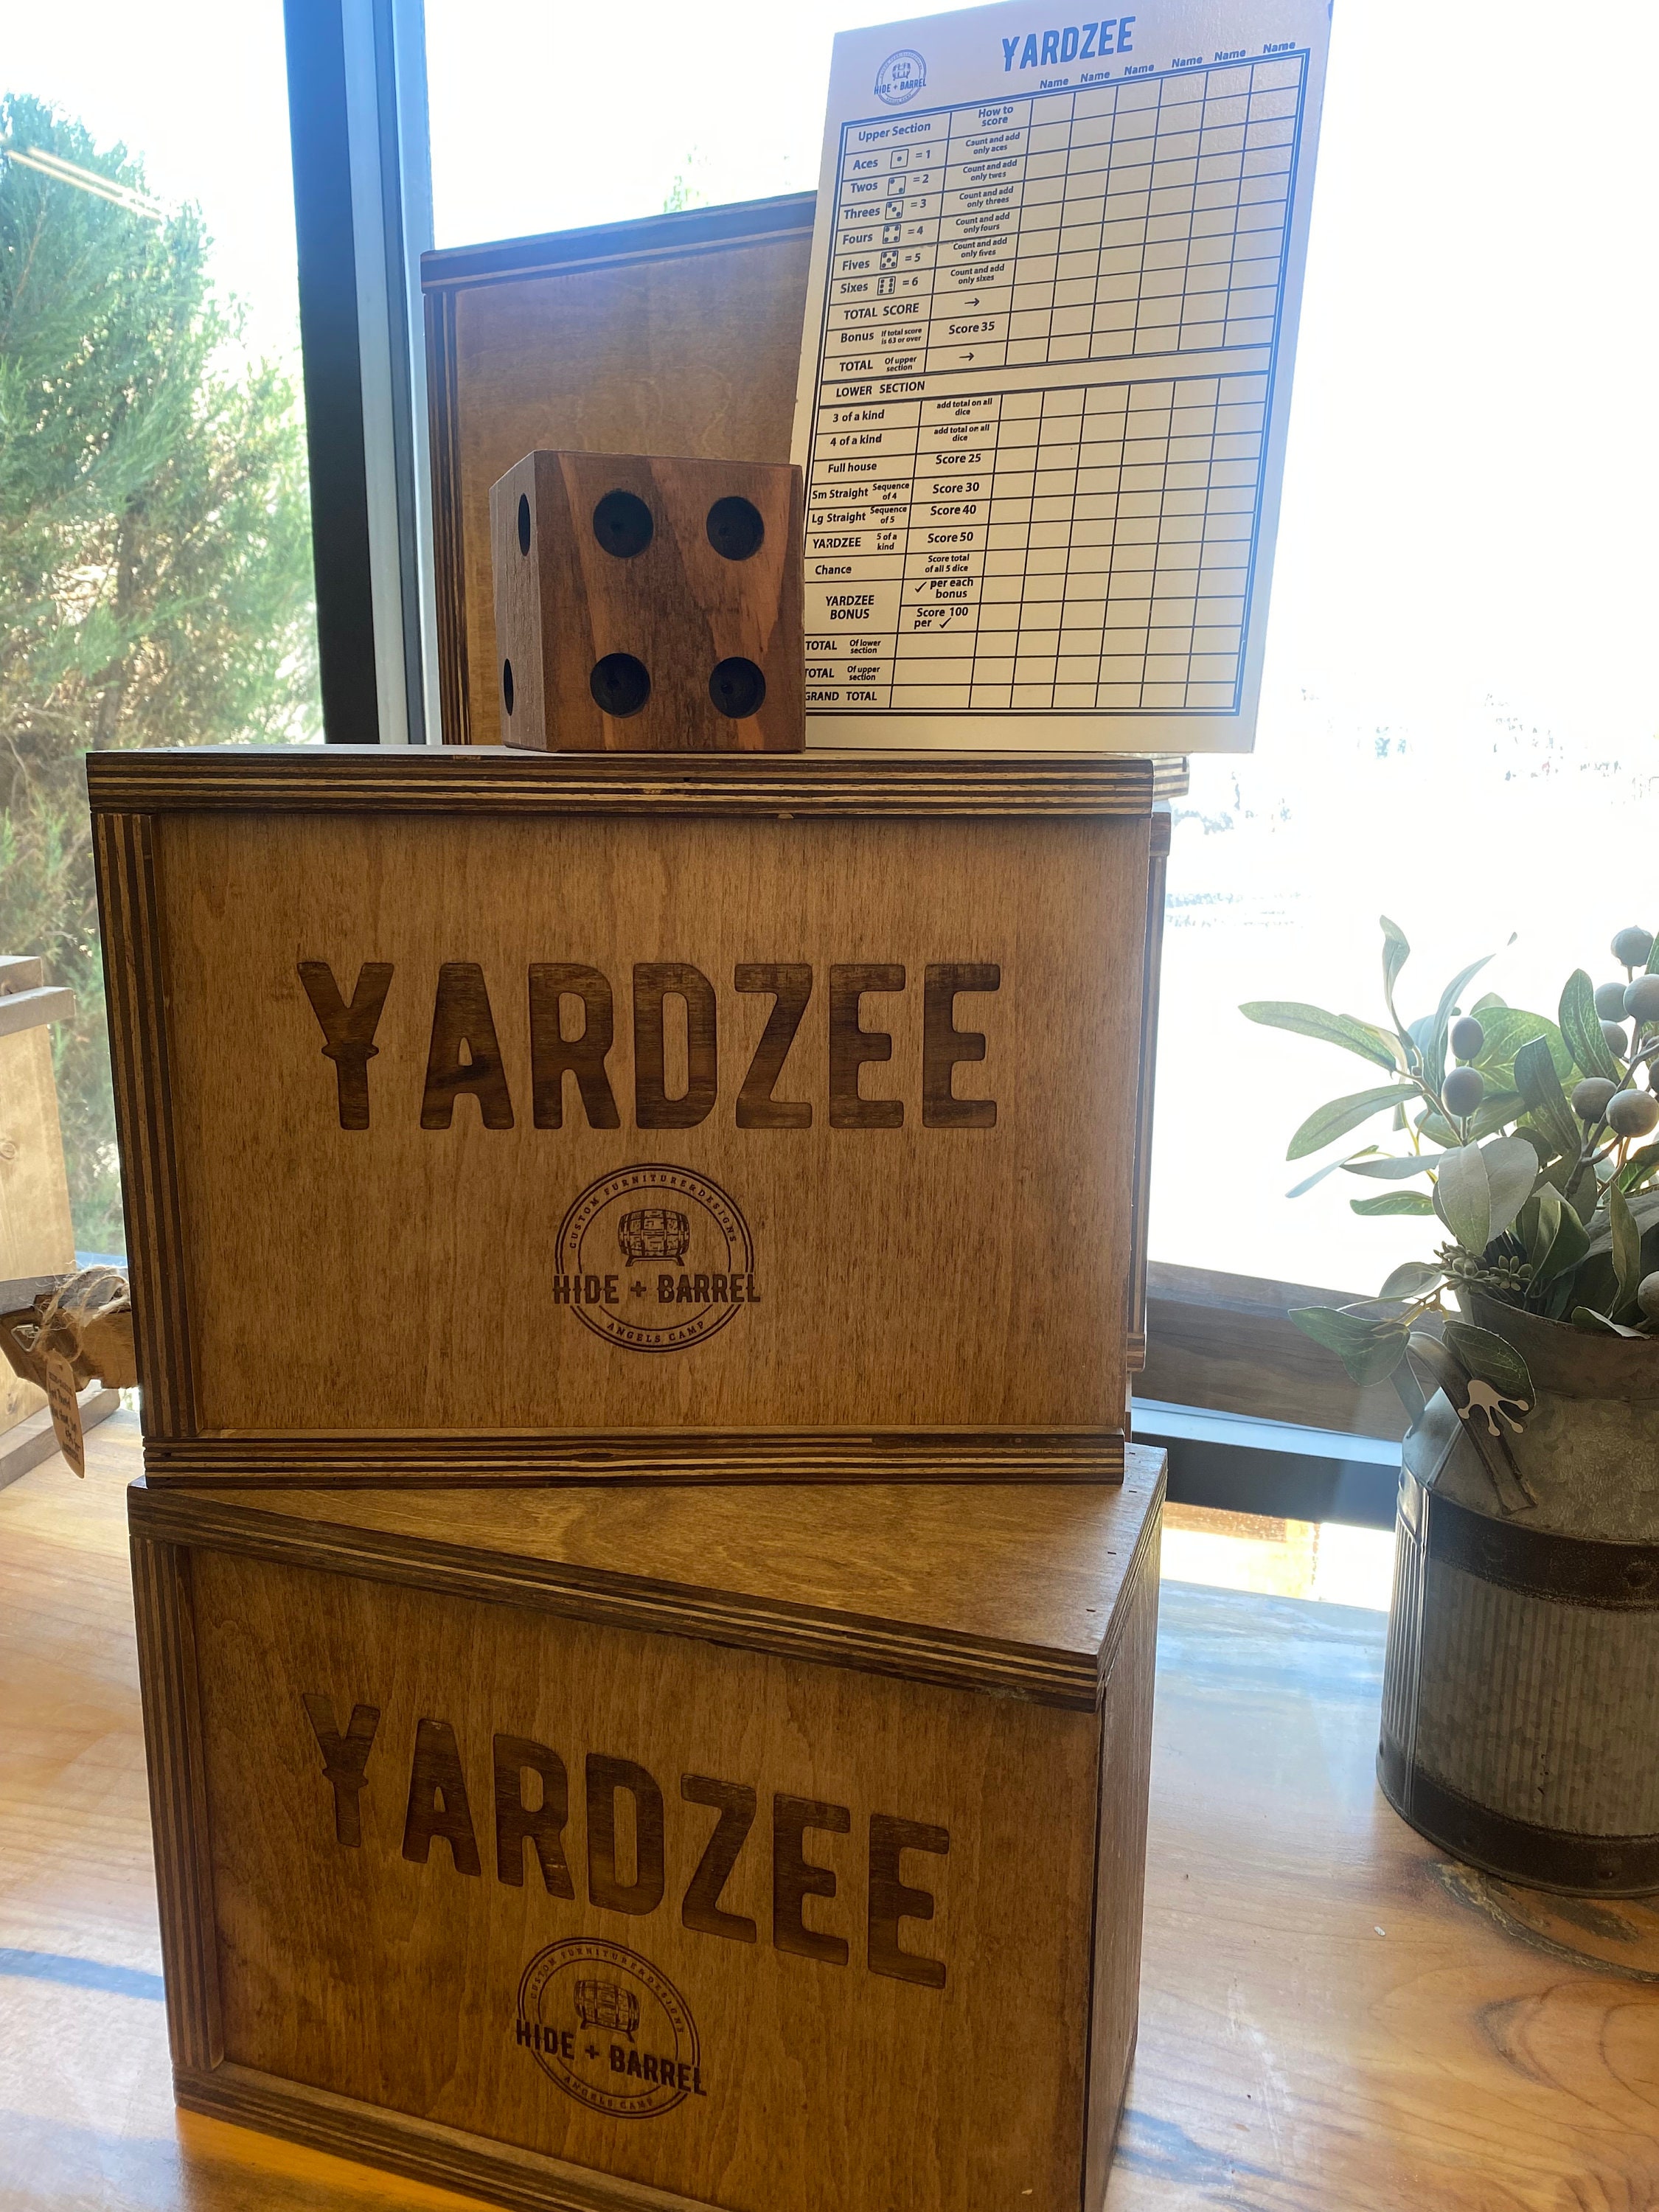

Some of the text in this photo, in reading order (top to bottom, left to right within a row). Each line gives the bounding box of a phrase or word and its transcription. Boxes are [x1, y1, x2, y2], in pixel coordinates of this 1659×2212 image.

[1002, 16, 1136, 72] YARDZEE
[1040, 42, 1295, 89] Name Name Name Name Name Name
[874, 78, 926, 94] HIDE BARREL
[978, 106, 1014, 118] How to
[981, 116, 1008, 127] score
[858, 122, 931, 142] Upper Section
[966, 132, 1020, 147] Count and add
[926, 150, 931, 159] 1
[973, 146, 990, 155] only
[853, 159, 878, 170] Aces
[963, 159, 1018, 173] Count and add
[922, 174, 929, 184] 2
[970, 173, 987, 181] only
[850, 182, 878, 193] Twos
[959, 186, 1014, 200] Count and add
[920, 198, 926, 208] 3
[967, 197, 1009, 208] only threes
[844, 208, 880, 219] Threes
[956, 212, 1010, 226] Count and add
[917, 226, 923, 234] 4
[964, 225, 980, 234] only
[843, 234, 873, 245] Fours
[953, 237, 1007, 250] Count and add
[914, 253, 921, 262] 5
[961, 250, 978, 258] only
[842, 260, 870, 271] Fives
[950, 263, 1005, 276] Count and add
[911, 276, 918, 286] 6
[958, 274, 994, 285] only sixes
[840, 282, 868, 294] Sixes
[844, 302, 919, 320] TOTAL SCORE
[888, 328, 903, 336] total
[948, 321, 995, 335] Score 35
[841, 333, 874, 343] Bonus
[839, 360, 873, 372] TOTAL
[885, 355, 917, 366] Of upper
[886, 364, 912, 372] section
[836, 380, 925, 397] LOWER SECTION
[936, 400, 951, 409] add
[953, 399, 970, 408] total
[983, 397, 992, 406] all
[832, 414, 838, 422] 3
[842, 411, 853, 422] of
[862, 408, 885, 420] kind
[955, 408, 970, 416] dice
[934, 426, 949, 434] add
[950, 425, 967, 434] total
[830, 437, 836, 447] 4
[839, 436, 851, 445] of
[860, 433, 882, 445] kind
[936, 453, 981, 465] Score 25
[828, 462, 877, 473] Full house
[872, 483, 910, 492] Sequence
[932, 482, 980, 494] Score 30
[812, 487, 869, 500] Sm Straight
[883, 492, 891, 500] of
[870, 506, 907, 516] Sequence
[930, 504, 976, 516] Score 40
[812, 511, 866, 525] Lg Straight
[880, 515, 889, 524] of
[883, 532, 892, 540] of
[928, 532, 973, 543] Score 50
[813, 537, 861, 549] YARDZEE
[877, 542, 894, 551] kind
[951, 553, 970, 562] total
[815, 564, 852, 575] Chance
[925, 565, 934, 573] of
[930, 577, 973, 590] per each
[936, 588, 967, 599] bonus
[826, 594, 874, 606] YARDZEE
[830, 608, 869, 620] BONUS
[917, 607, 969, 617] Score 100
[914, 619, 932, 630] per
[806, 640, 838, 650] TOTAL
[849, 639, 881, 647] Of lower
[850, 646, 877, 654] section
[847, 665, 880, 675] Of upper
[846, 691, 877, 701] TOTAL
[296, 961, 1001, 1130] YARDZEE
[569, 1197, 599, 1248] CUSTOM
[553, 1274, 761, 1304] HIDE BARREL
[608, 1321, 705, 1342] ANGELS CAMP
[302, 1692, 950, 1989] YARDZEE
[531, 1958, 557, 1999] CUSTOM
[516, 2019, 706, 2096] HIDE BARREL
[563, 2076, 653, 2110] ANGELS CAMP
